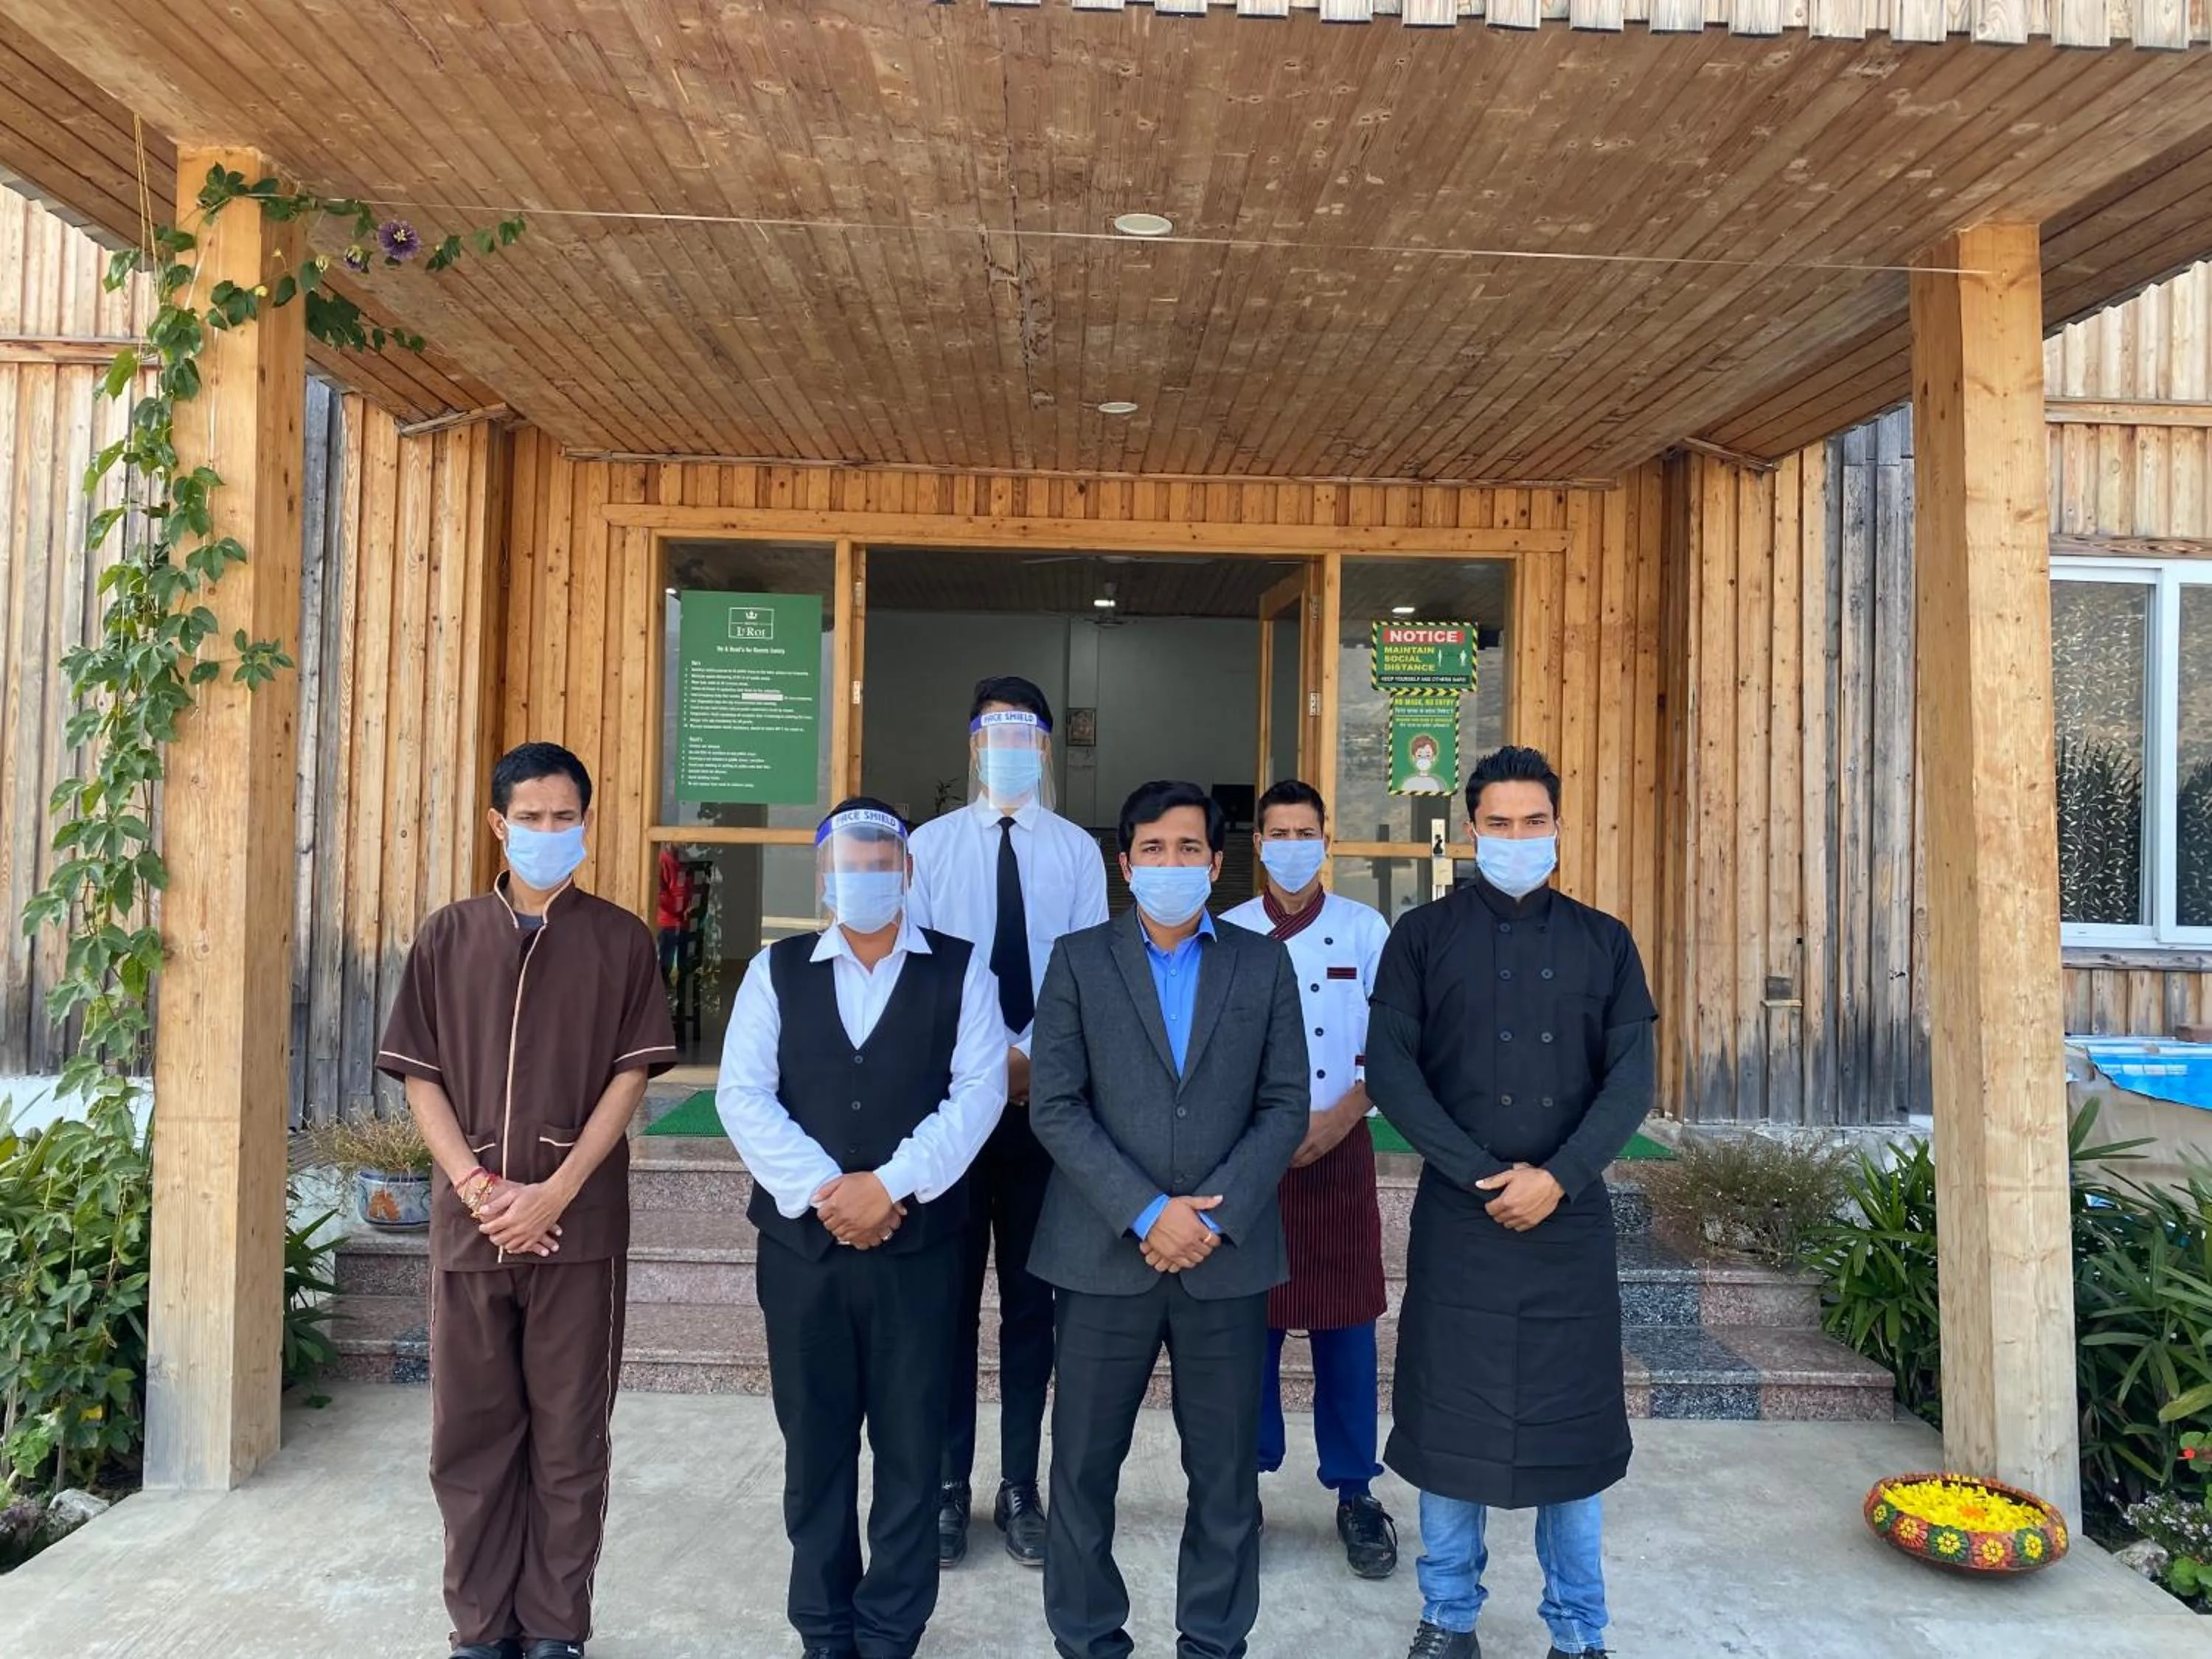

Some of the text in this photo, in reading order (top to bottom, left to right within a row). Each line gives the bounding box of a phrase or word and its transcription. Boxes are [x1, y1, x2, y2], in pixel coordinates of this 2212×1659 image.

[1389, 630, 1458, 642] NOTICE
[1384, 664, 1436, 672] DISTANCE
[985, 713, 1033, 723] FACE SHIELD
[836, 811, 896, 826] FACE SHIELD
